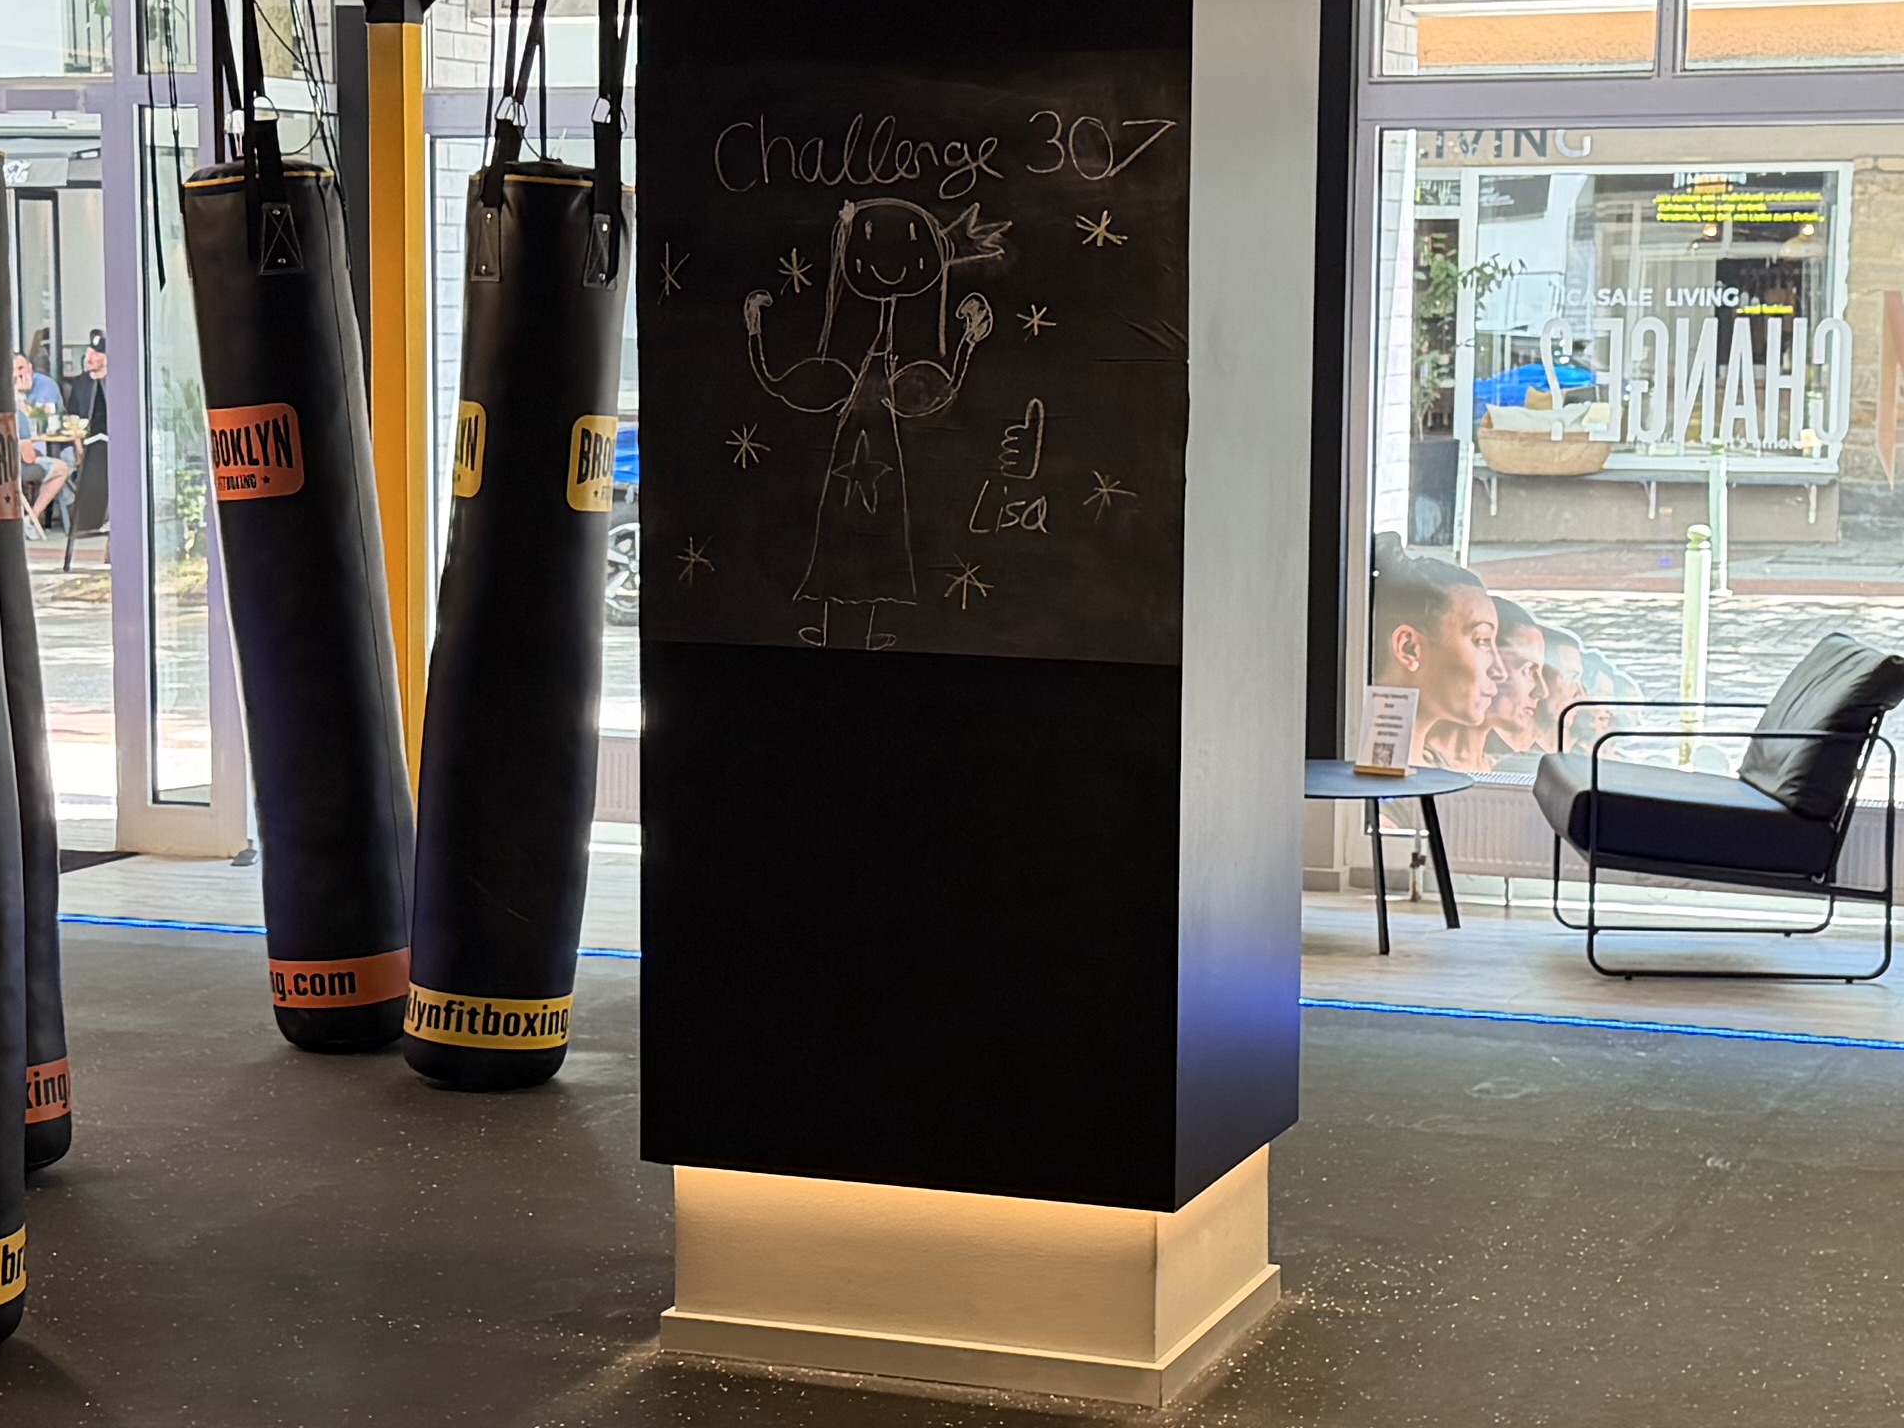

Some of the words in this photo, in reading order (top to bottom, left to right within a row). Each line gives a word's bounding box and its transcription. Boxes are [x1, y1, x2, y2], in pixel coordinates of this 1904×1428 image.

[715, 113, 1004, 200] Challenge
[1025, 110, 1177, 181] 307
[1566, 287, 1654, 308] CASALE
[1664, 286, 1740, 308] LIVING
[968, 478, 1052, 536] Lisa
